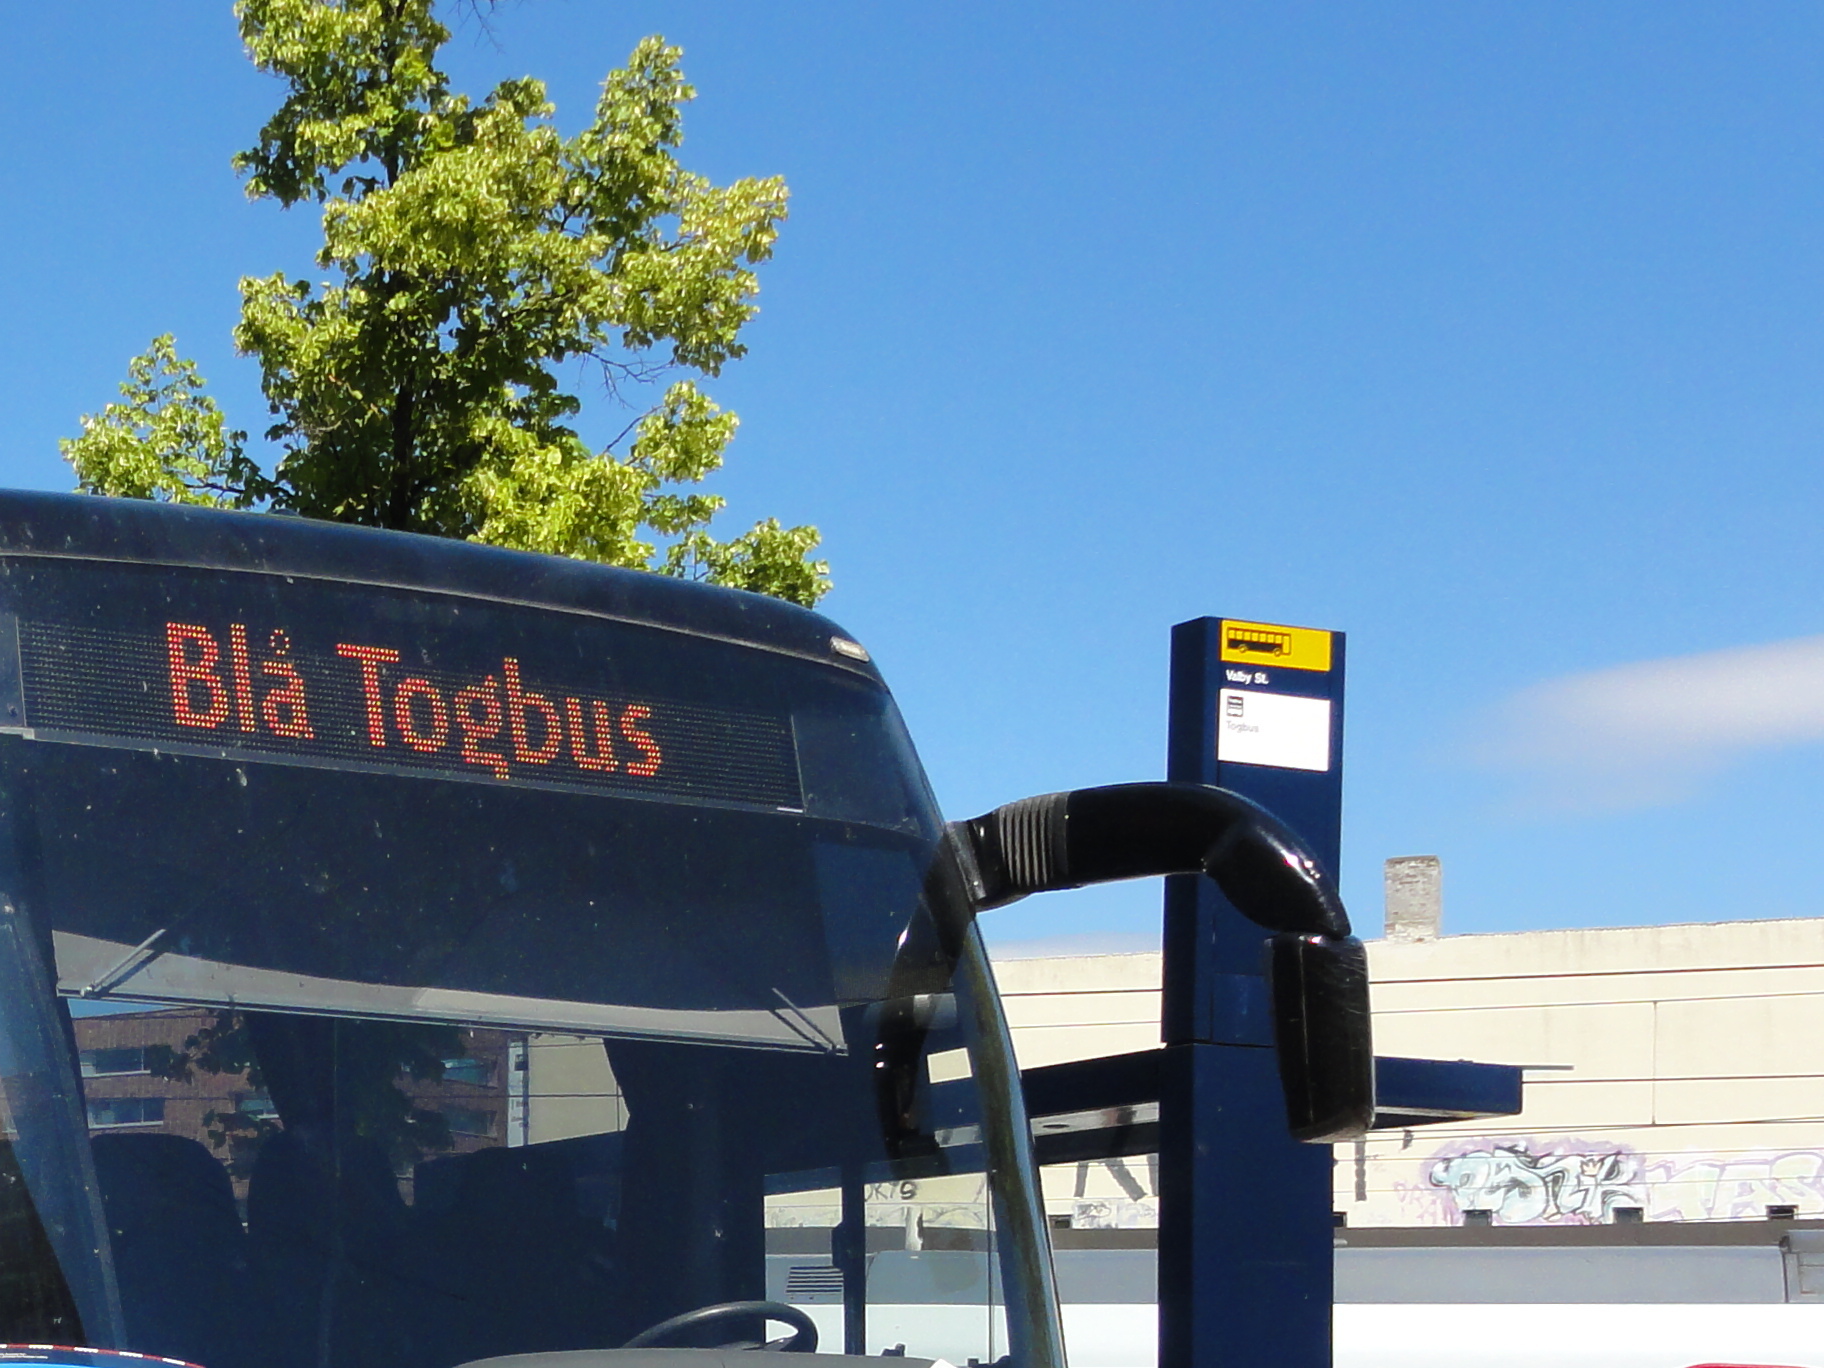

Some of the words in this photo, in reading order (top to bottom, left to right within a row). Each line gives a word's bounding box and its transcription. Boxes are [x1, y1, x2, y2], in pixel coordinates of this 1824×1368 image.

[166, 621, 314, 739] Blå
[336, 642, 663, 780] Togbus
[1226, 720, 1259, 733] Togbus
